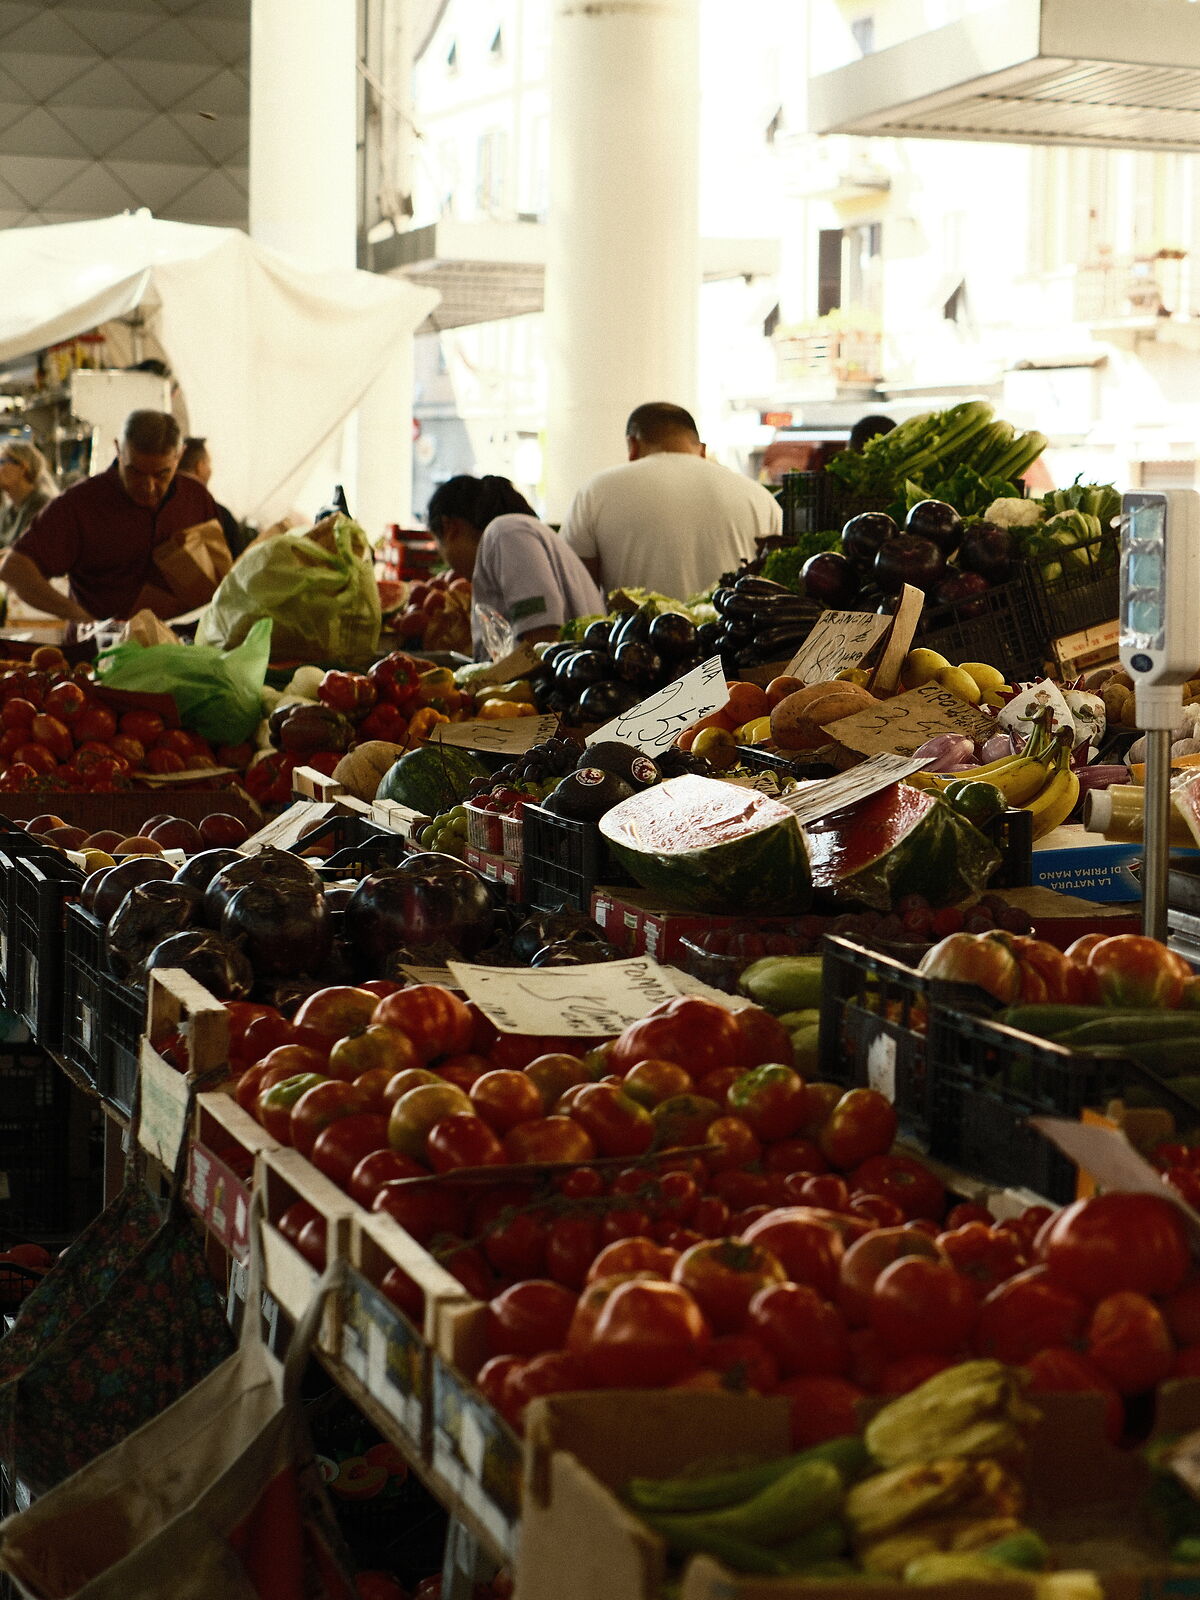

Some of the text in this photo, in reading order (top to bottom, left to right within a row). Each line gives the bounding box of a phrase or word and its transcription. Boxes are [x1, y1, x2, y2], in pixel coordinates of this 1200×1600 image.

[701, 654, 722, 685] UVA
[1039, 866, 1121, 880] DI PRIMA MANO
[1050, 877, 1112, 890] LA NATURA
